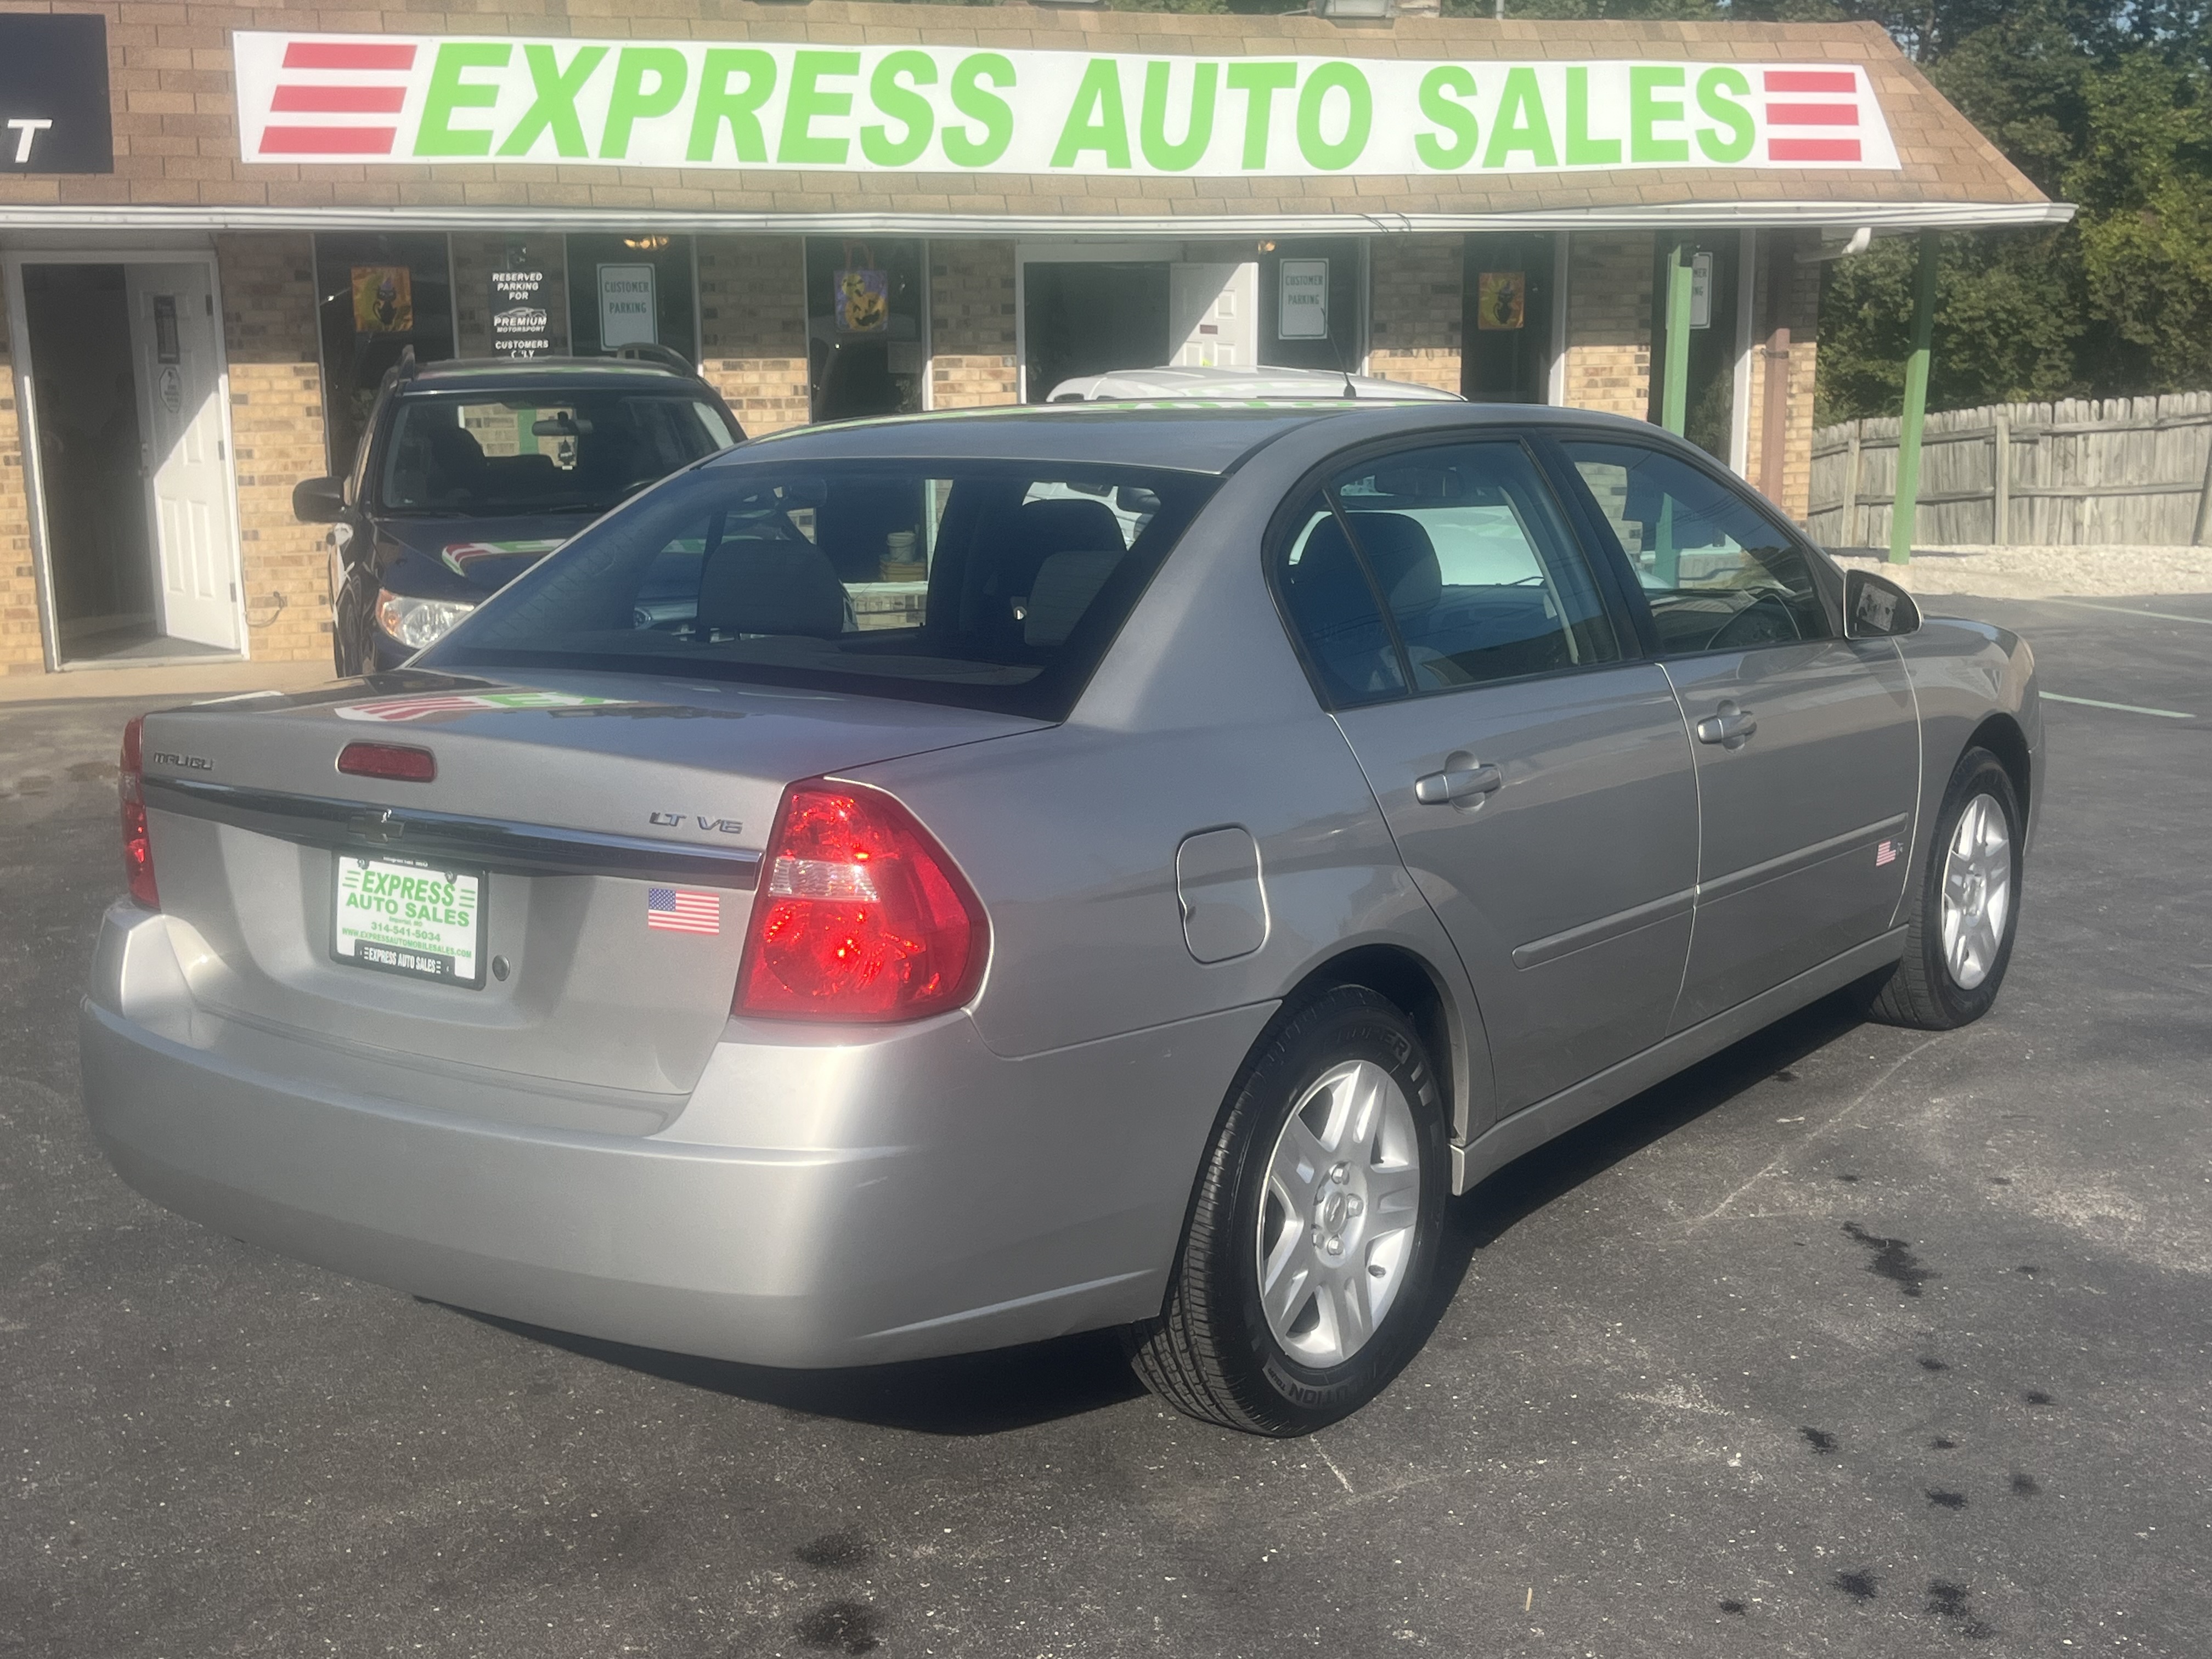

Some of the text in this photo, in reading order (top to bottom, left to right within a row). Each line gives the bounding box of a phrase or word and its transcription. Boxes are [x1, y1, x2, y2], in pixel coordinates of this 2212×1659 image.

[414, 42, 1756, 171] EXPRESS AUTO SALES
[492, 272, 543, 281] RESERVED
[1285, 275, 1323, 286] CUSTOMER
[497, 282, 539, 291] PARKING
[605, 281, 650, 293] CUSTOMER
[509, 291, 529, 301] FOR
[1288, 294, 1320, 305] PARKING
[609, 302, 647, 314] PARKING
[494, 317, 548, 327] PREMIUM
[495, 340, 549, 350] CUSTOMERS
[154, 751, 213, 771] MALIBU
[649, 812, 744, 834] LT V6
[362, 870, 456, 907] EXPRESS
[346, 892, 470, 927] AUTO SALES
[371, 922, 441, 942] 314-541-5034
[342, 927, 472, 958] WWW.EXPRESSAUTOMOBILESALES.COM
[369, 947, 436, 973] EXPRESS AUTO SALES
